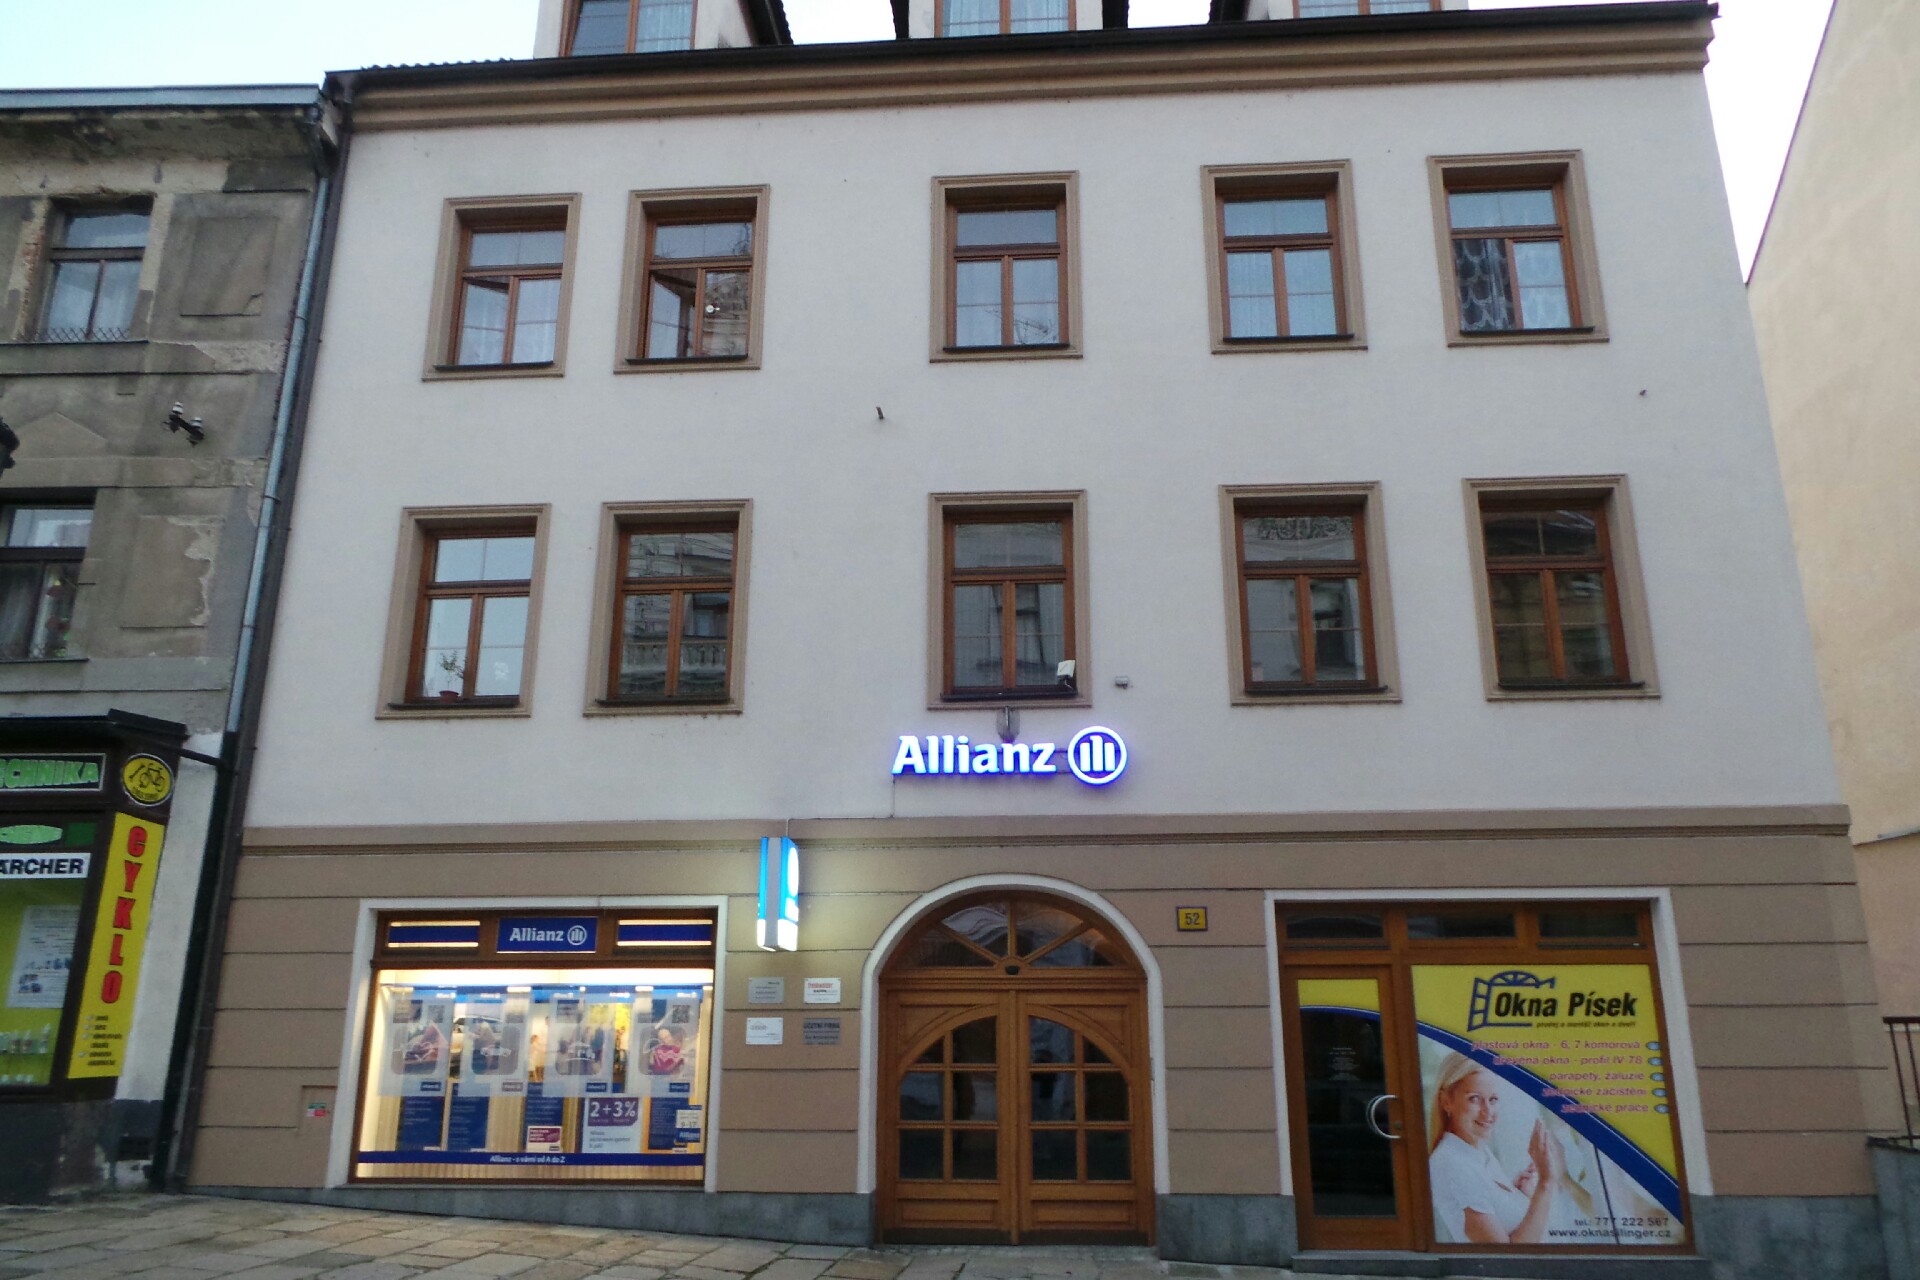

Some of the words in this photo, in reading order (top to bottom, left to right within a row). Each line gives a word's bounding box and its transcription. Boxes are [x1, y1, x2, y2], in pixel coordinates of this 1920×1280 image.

[891, 735, 1057, 775] Allianz
[101, 826, 148, 1004] CYKLO
[1185, 912, 1201, 926] 52
[509, 927, 564, 942] Allianz
[1494, 991, 1558, 1017] Okna
[1568, 991, 1638, 1017] Písek
[1522, 1040, 1549, 1049] okna
[1574, 1040, 1581, 1049] 7
[1629, 1055, 1643, 1064] 78
[1622, 1217, 1643, 1226] 222
